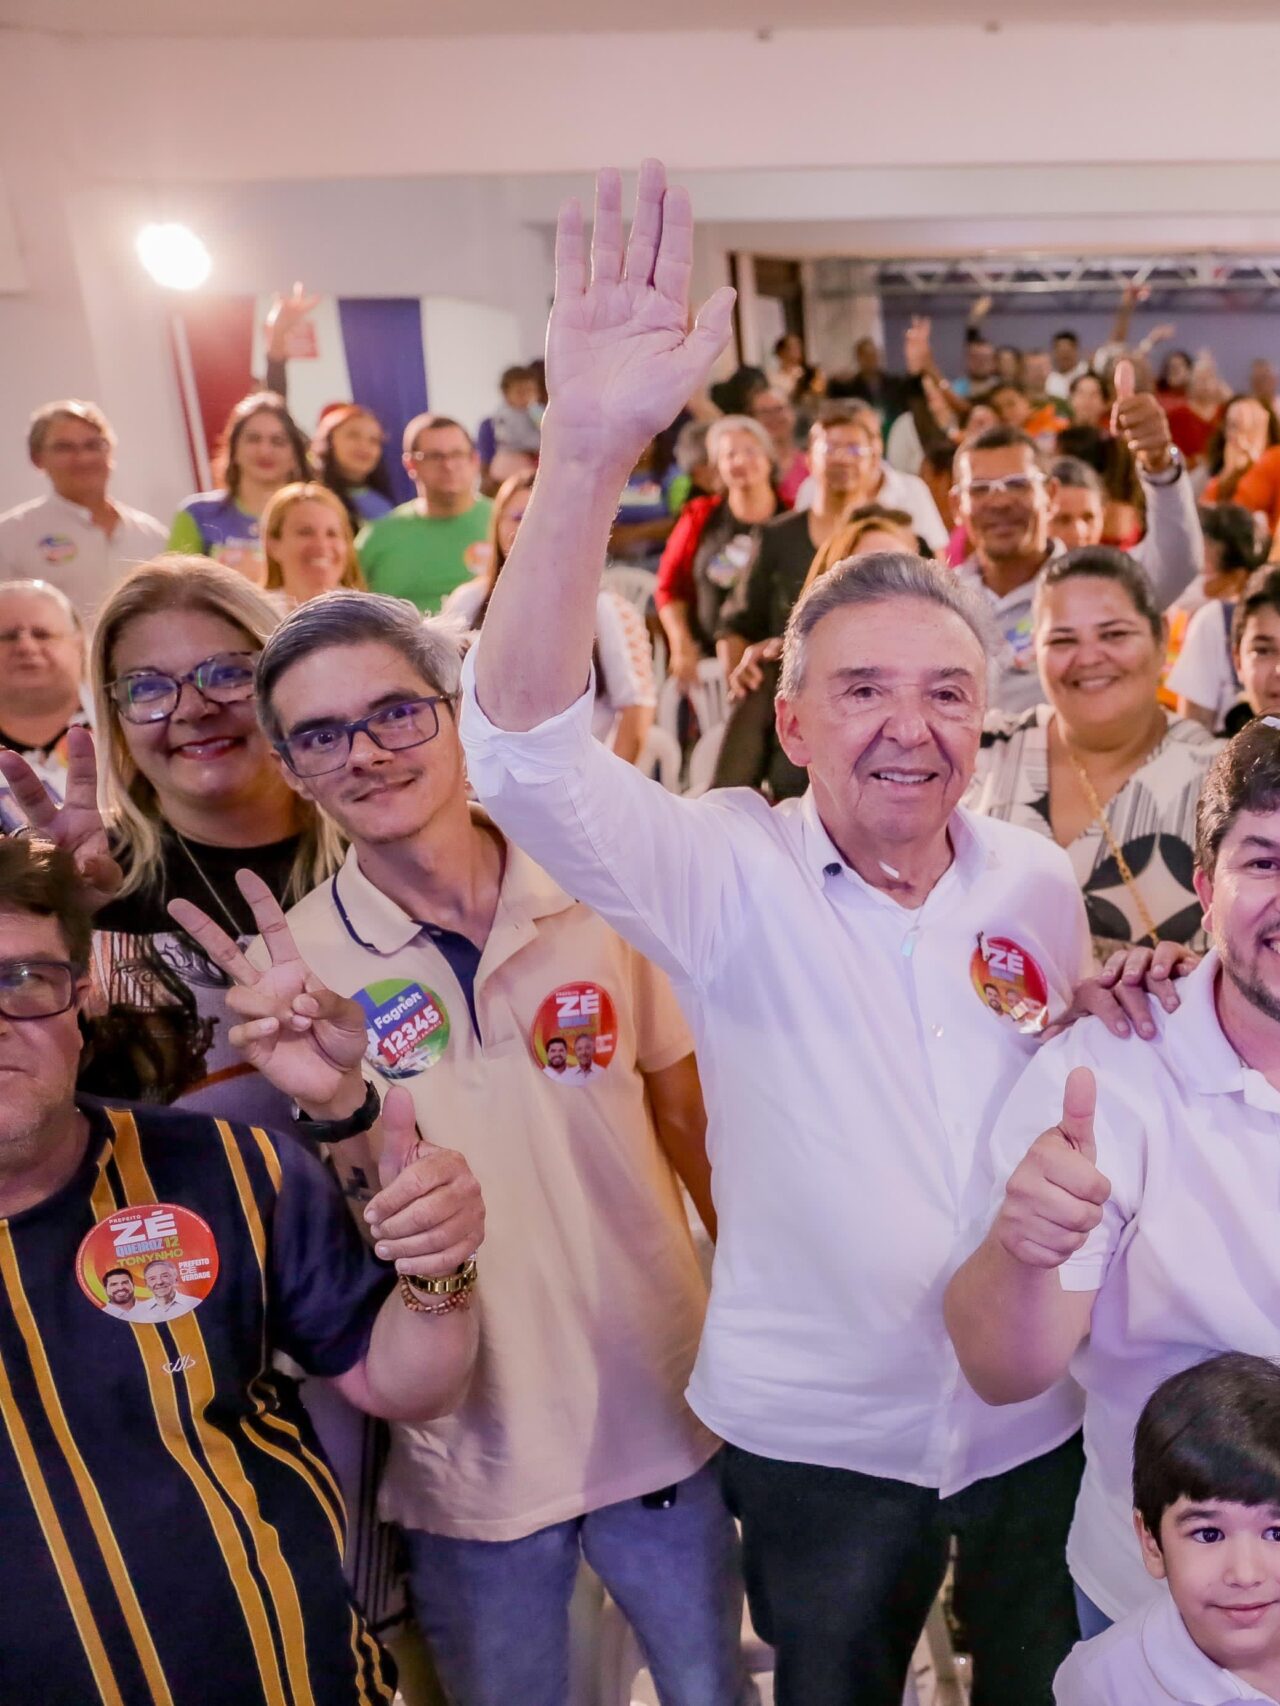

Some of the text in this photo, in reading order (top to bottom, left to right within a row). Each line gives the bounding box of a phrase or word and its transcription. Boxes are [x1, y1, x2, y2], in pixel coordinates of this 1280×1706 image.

[988, 947, 1025, 977] ZÉ
[373, 991, 423, 1030] Fagner
[555, 988, 600, 1018] ZÉ
[382, 1004, 440, 1056] 12345
[108, 1214, 142, 1224] PREFEITO
[110, 1209, 178, 1247] ZÉ
[115, 1235, 179, 1258] QUEIROZ 12
[116, 1248, 184, 1267] TONYNHO
[178, 1257, 210, 1268] PREFEITO
[179, 1265, 197, 1276] DE
[181, 1270, 211, 1282] VERDADE
